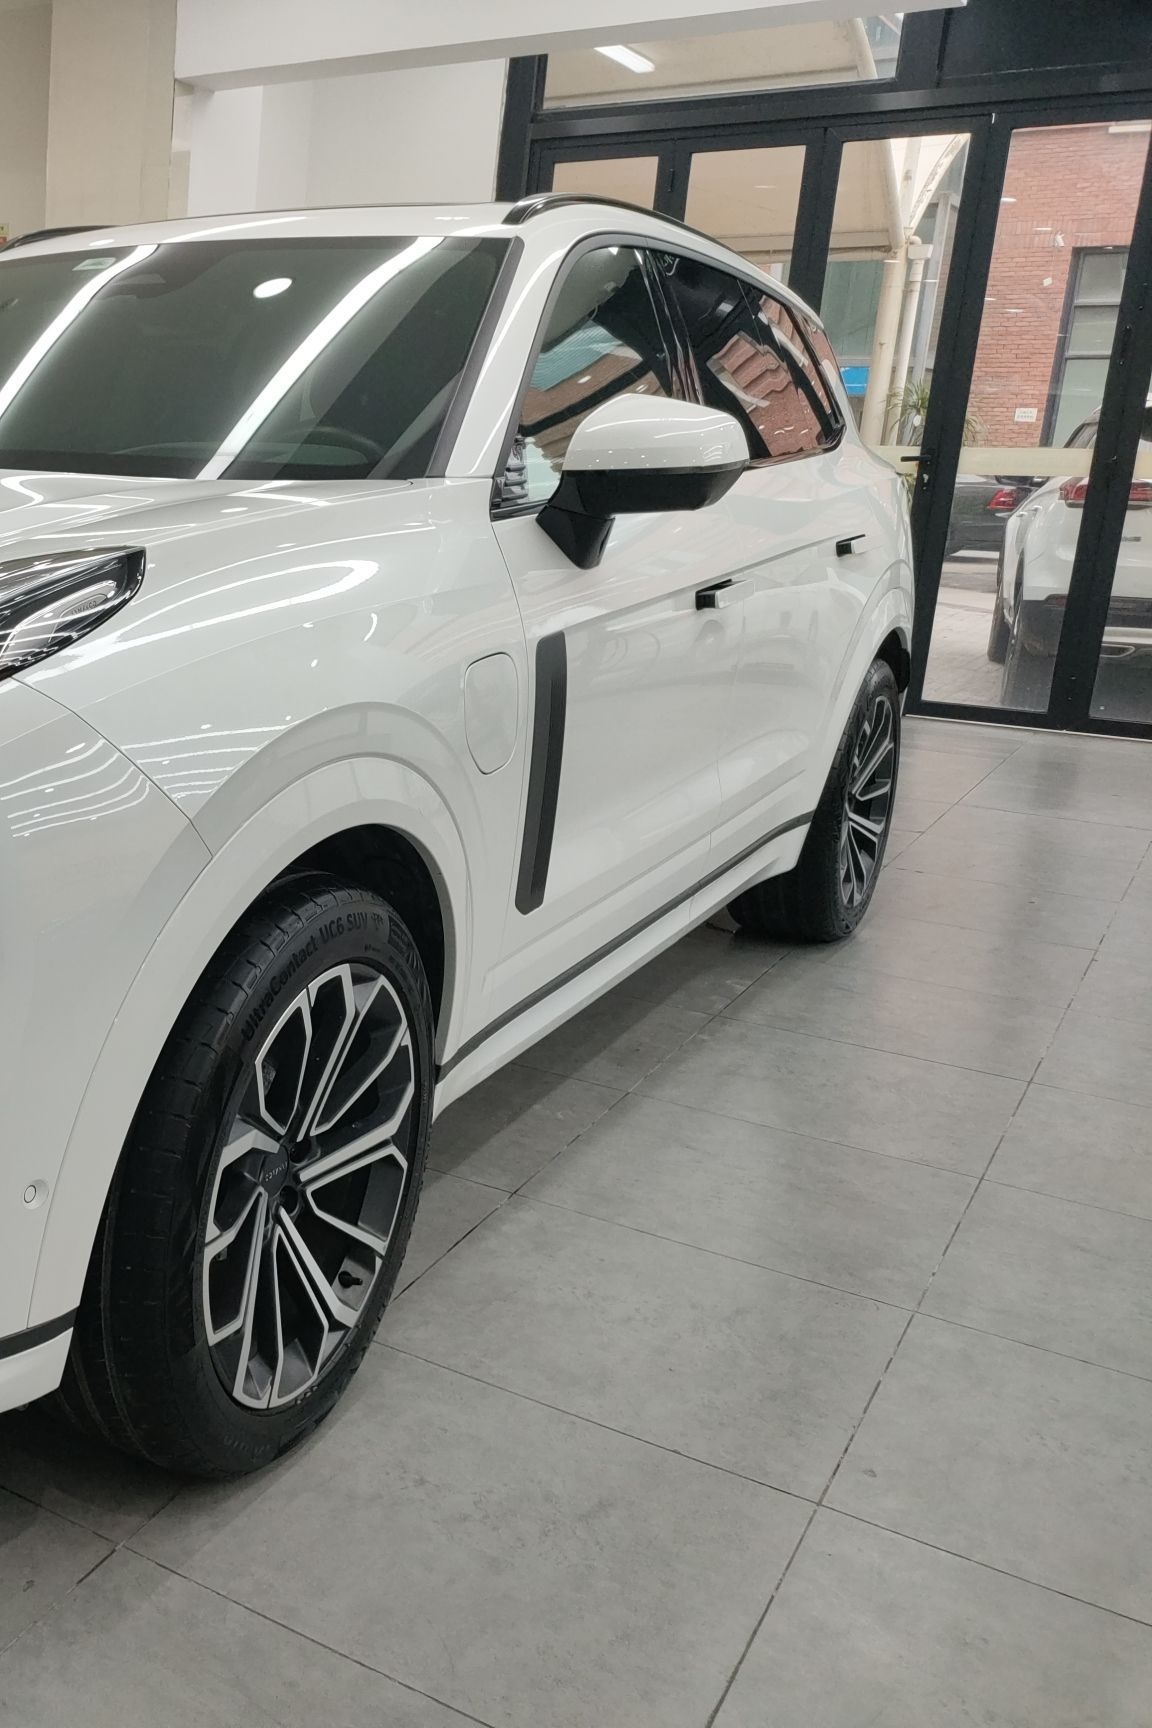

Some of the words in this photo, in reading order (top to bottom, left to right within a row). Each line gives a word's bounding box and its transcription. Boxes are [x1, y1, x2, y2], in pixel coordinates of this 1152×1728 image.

[241, 935, 319, 1041] UltraContact
[319, 918, 345, 944] UC6
[347, 912, 369, 932] SUV
